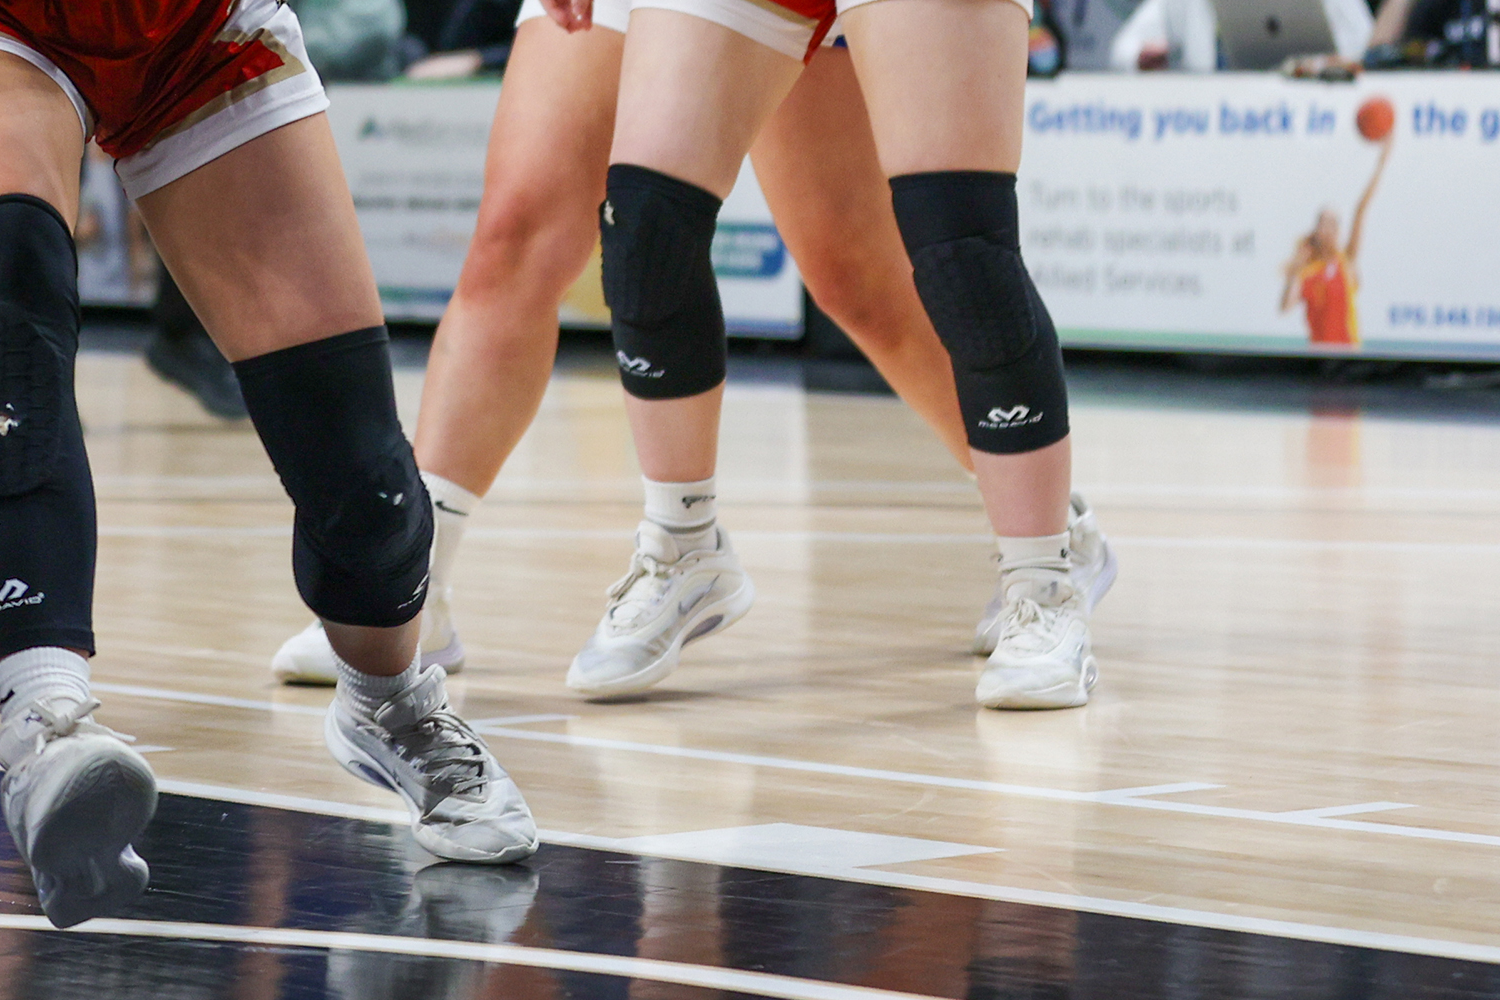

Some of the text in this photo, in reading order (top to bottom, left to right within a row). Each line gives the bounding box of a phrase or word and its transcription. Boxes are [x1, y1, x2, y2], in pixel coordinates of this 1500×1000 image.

[1029, 101, 1142, 140] Getting
[1154, 107, 1209, 141] you
[1218, 101, 1293, 134] back
[1306, 102, 1336, 133] in
[1413, 101, 1468, 136] the
